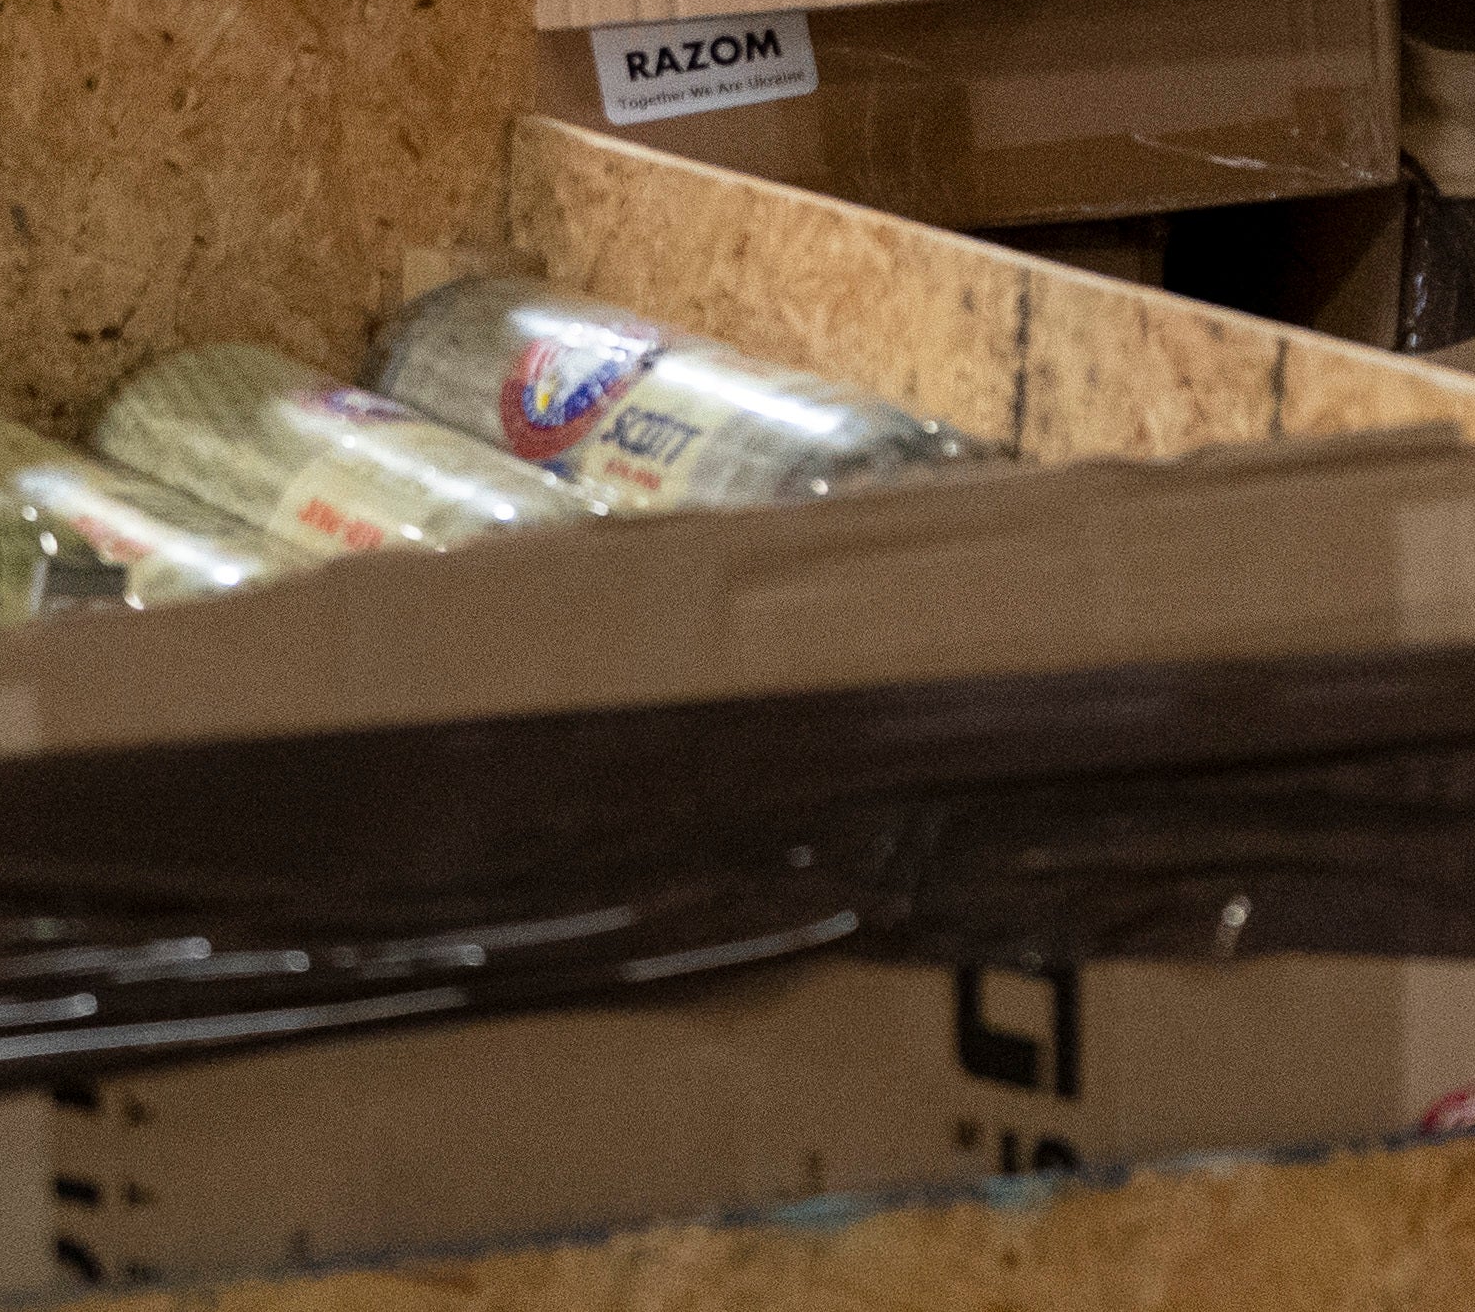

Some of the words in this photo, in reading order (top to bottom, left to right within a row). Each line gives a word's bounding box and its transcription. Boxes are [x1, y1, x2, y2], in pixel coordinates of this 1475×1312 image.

[626, 29, 782, 82] RAZOM
[619, 90, 685, 111] Together
[690, 85, 713, 99] We
[719, 80, 743, 95] Are
[748, 70, 805, 89] Ukraine
[600, 405, 702, 463] SCOTT
